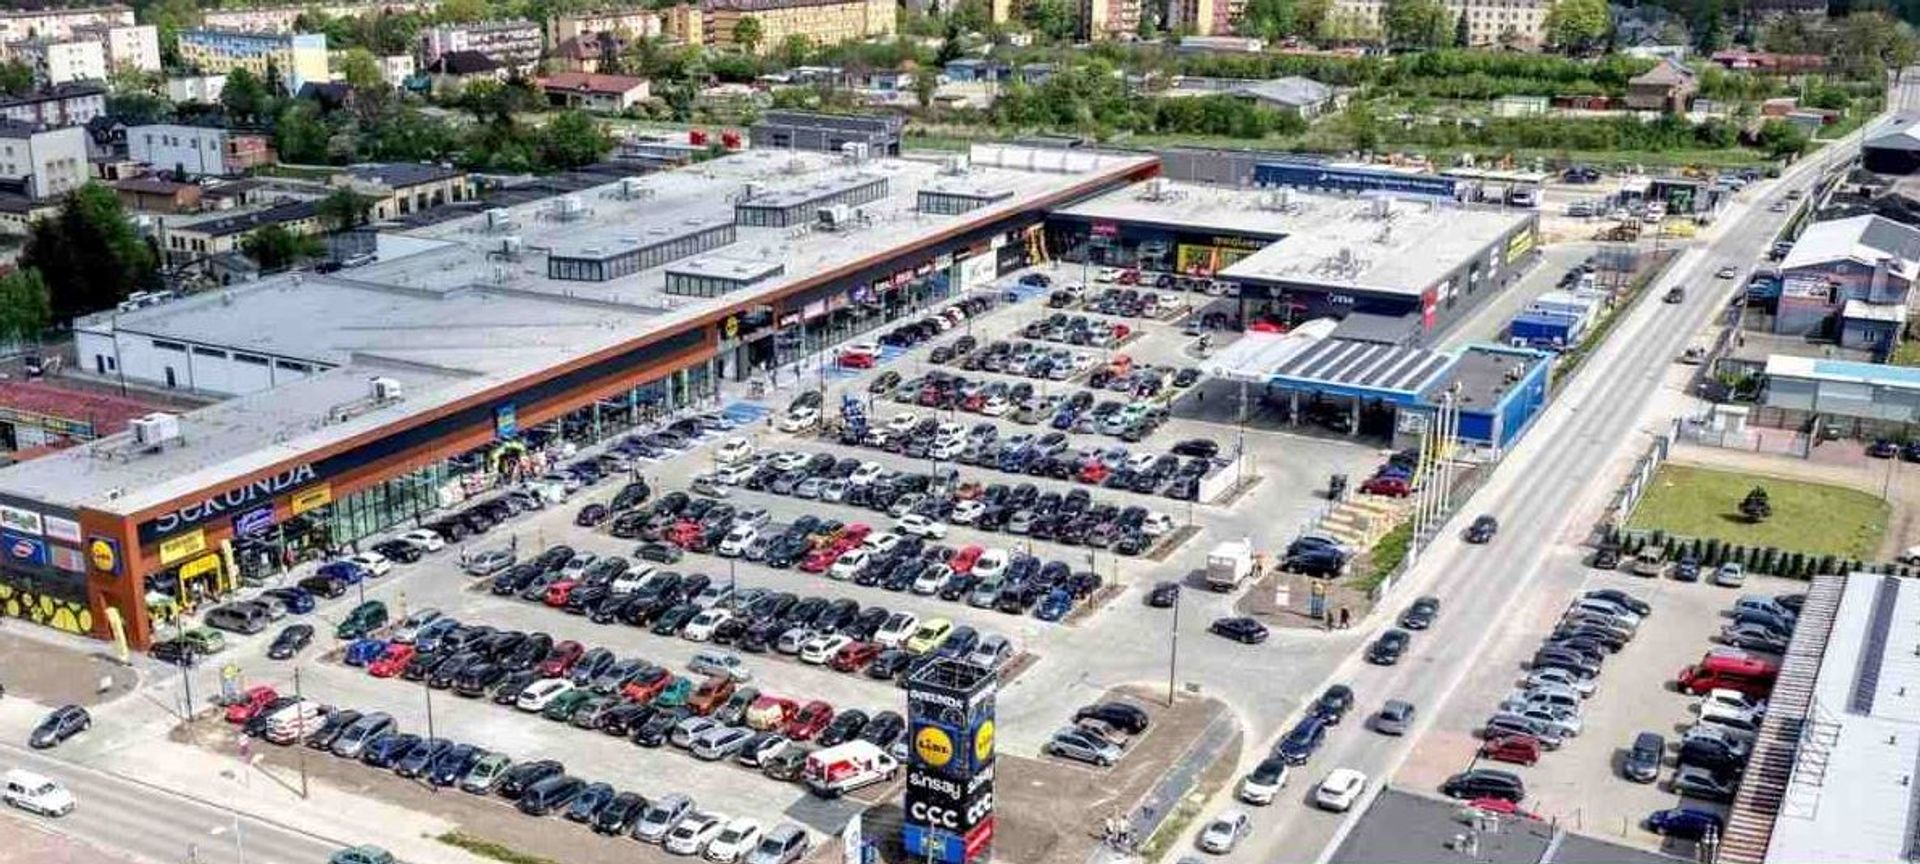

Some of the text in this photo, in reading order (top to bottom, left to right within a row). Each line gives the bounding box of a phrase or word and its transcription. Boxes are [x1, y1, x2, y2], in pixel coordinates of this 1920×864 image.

[909, 770, 961, 800] sinsay
[911, 801, 959, 829] CCC
[967, 792, 992, 825] CCC
